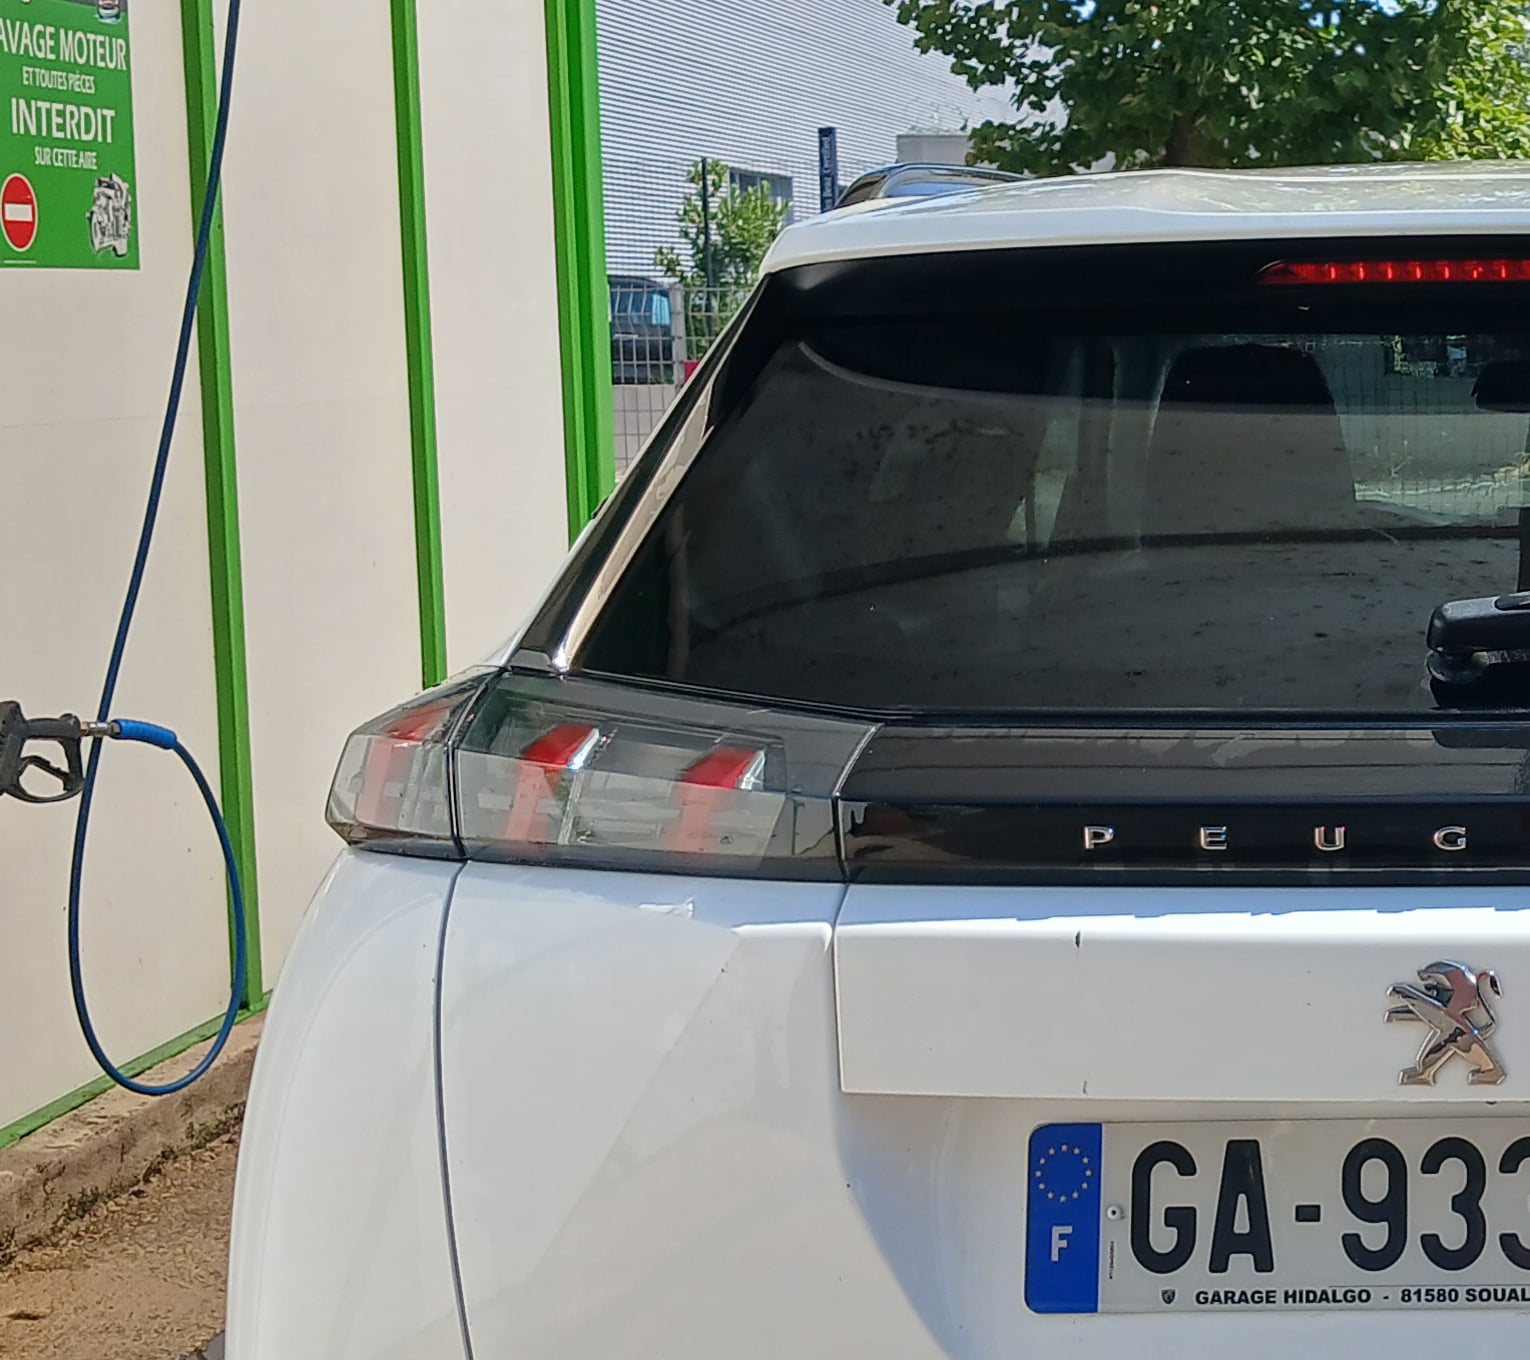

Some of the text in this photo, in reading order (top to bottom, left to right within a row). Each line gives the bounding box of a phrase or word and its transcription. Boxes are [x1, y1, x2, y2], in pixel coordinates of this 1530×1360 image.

[59, 28, 127, 71] MOTEUR
[22, 66, 33, 86] ET
[35, 68, 67, 90] TOUTES
[11, 97, 116, 144] INTERDIT
[34, 146, 98, 170] SUR CETTE AIRE
[1051, 1225, 1073, 1262] F
[1195, 1289, 1277, 1305] GARAGE
[1283, 1288, 1372, 1305] HIDALGO
[1400, 1288, 1460, 1303] 81580
